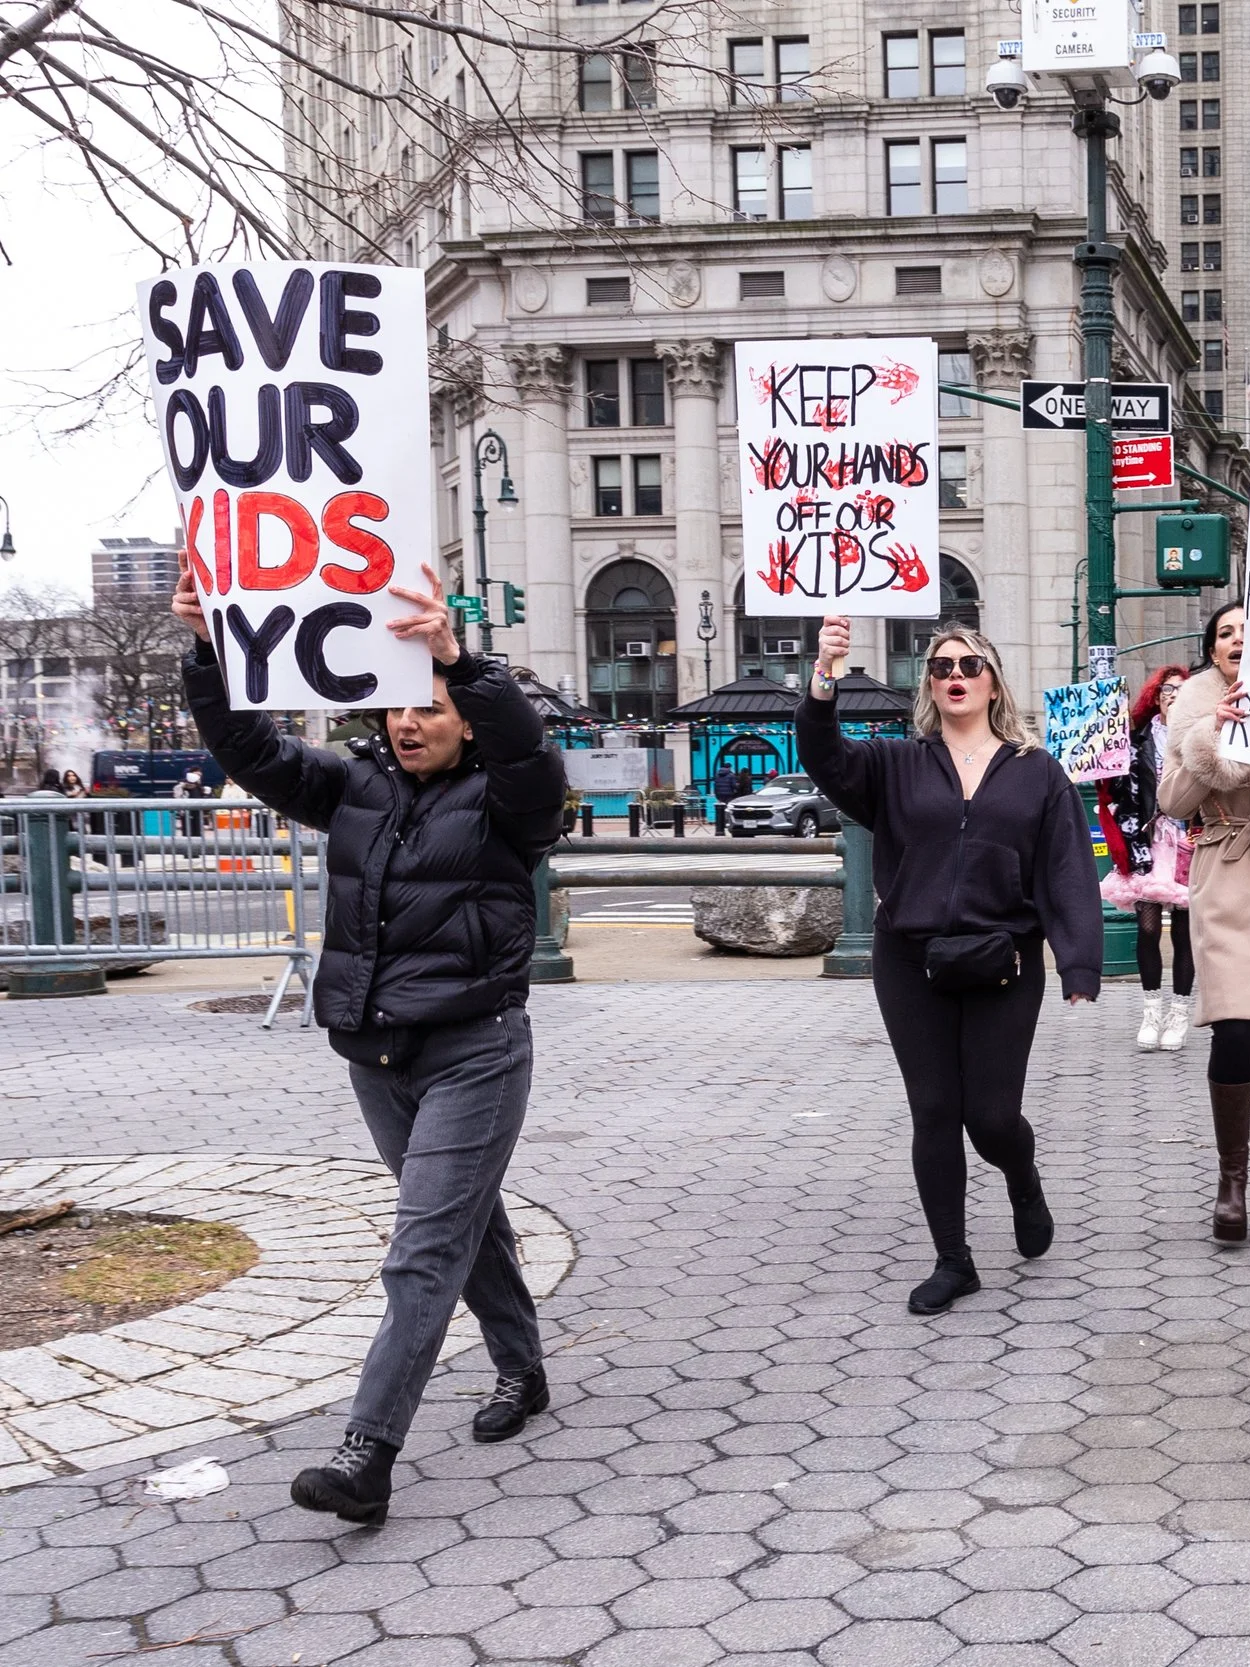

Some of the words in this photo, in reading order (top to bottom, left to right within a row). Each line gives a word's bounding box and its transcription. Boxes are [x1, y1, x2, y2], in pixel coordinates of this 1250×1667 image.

[1052, 7, 1096, 19] SECURITY
[1055, 44, 1094, 55] CAMERA
[1136, 34, 1163, 46] NYPD
[149, 268, 384, 385] SAVE
[771, 363, 877, 428] KEEP
[1045, 397, 1084, 416] ONE
[1110, 399, 1150, 417] WAY
[165, 382, 364, 492] OUR
[1122, 442, 1163, 454] STANDING
[748, 437, 833, 490] YOUR
[838, 442, 930, 486] HANDS
[776, 501, 833, 532] OFF
[836, 497, 895, 531] OUR
[180, 489, 395, 595] KIDS
[780, 530, 899, 598] KIDS
[1045, 686, 1082, 707] Why
[1048, 729, 1080, 743] learn
[1108, 717, 1126, 735] B4
[1053, 743, 1065, 758] it
[114, 765, 139, 774] NYC
